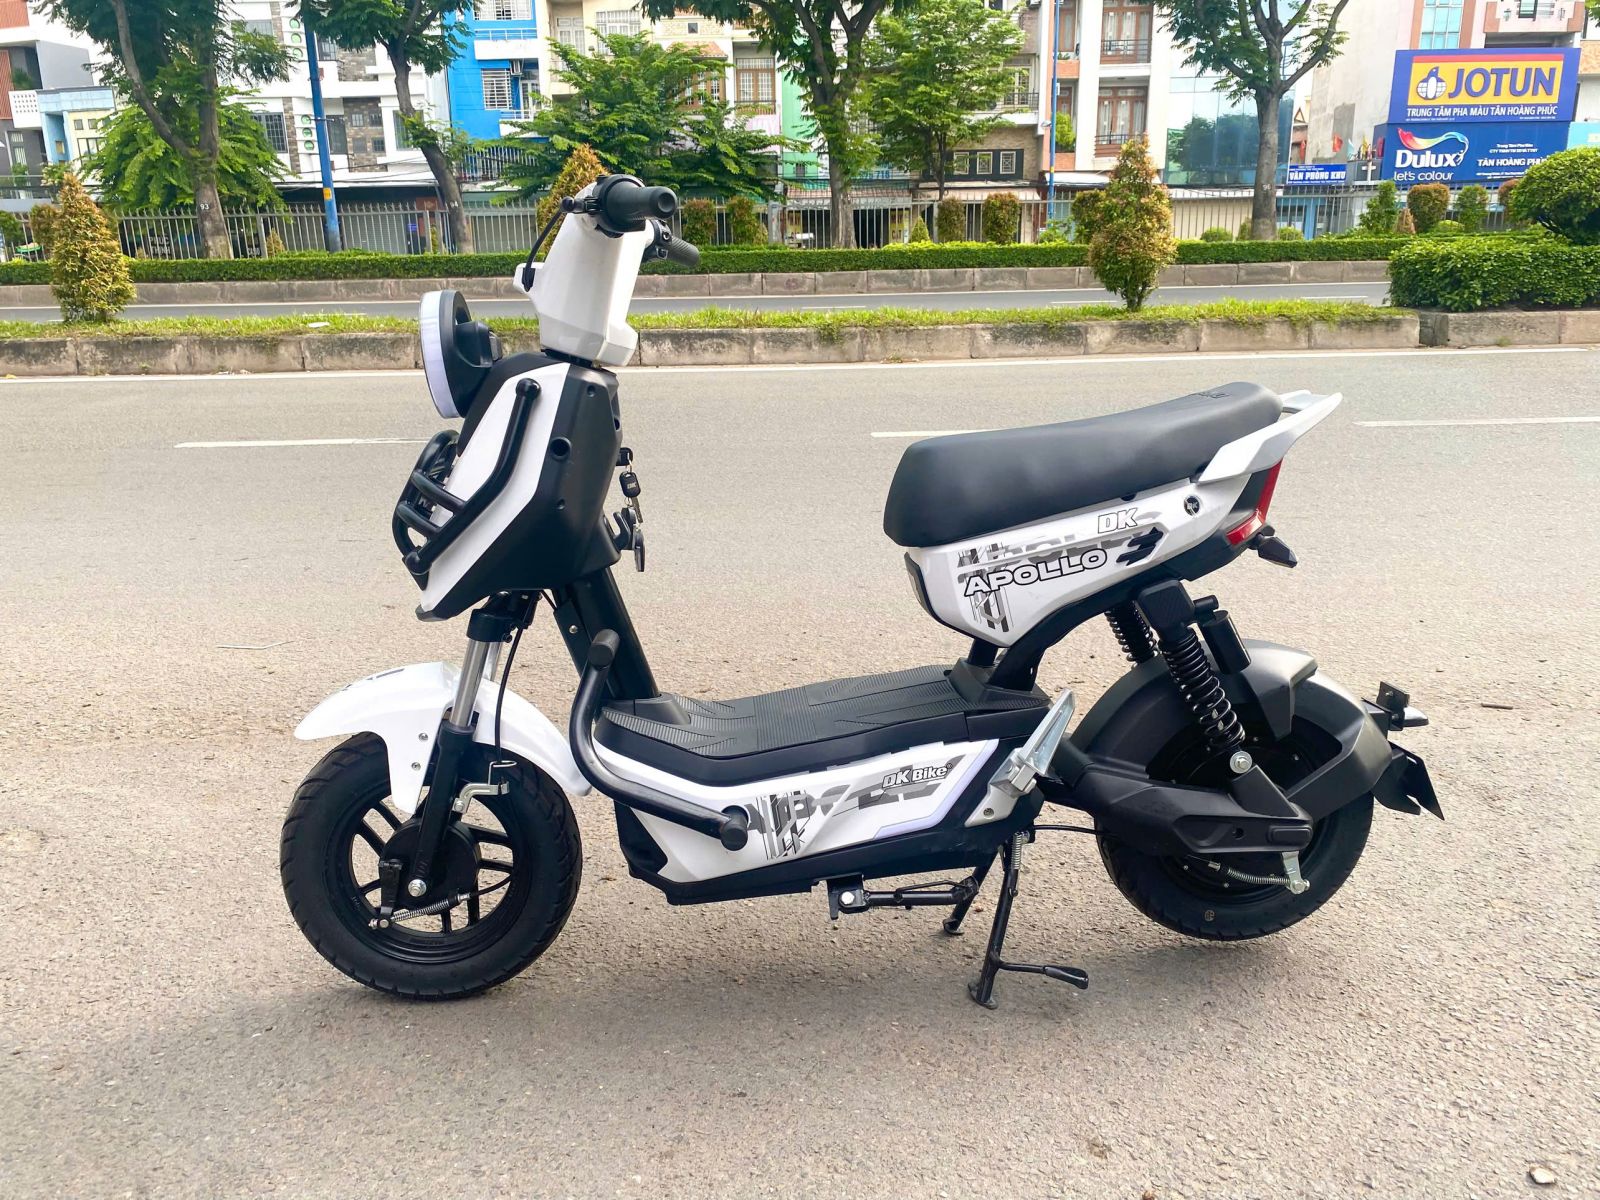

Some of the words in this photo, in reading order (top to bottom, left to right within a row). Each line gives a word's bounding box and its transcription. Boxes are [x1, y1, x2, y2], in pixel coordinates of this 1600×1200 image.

[1448, 67, 1556, 99] JOTUN
[1407, 107, 1432, 117] TRUNG
[1434, 105, 1451, 117] TÂM
[1452, 107, 1468, 116] PHA
[1470, 105, 1488, 116] MÀU
[1507, 104, 1536, 115] HOÀNG
[1537, 104, 1558, 115] PHÚC
[1395, 149, 1457, 169] Dulux
[1478, 157, 1495, 167] TÂN
[1496, 156, 1526, 167] HOÀNG
[1393, 170, 1416, 181] let's
[1417, 170, 1454, 181] colour
[1098, 507, 1138, 534] DK
[964, 548, 1108, 597] APOLLO
[882, 769, 911, 788] DK
